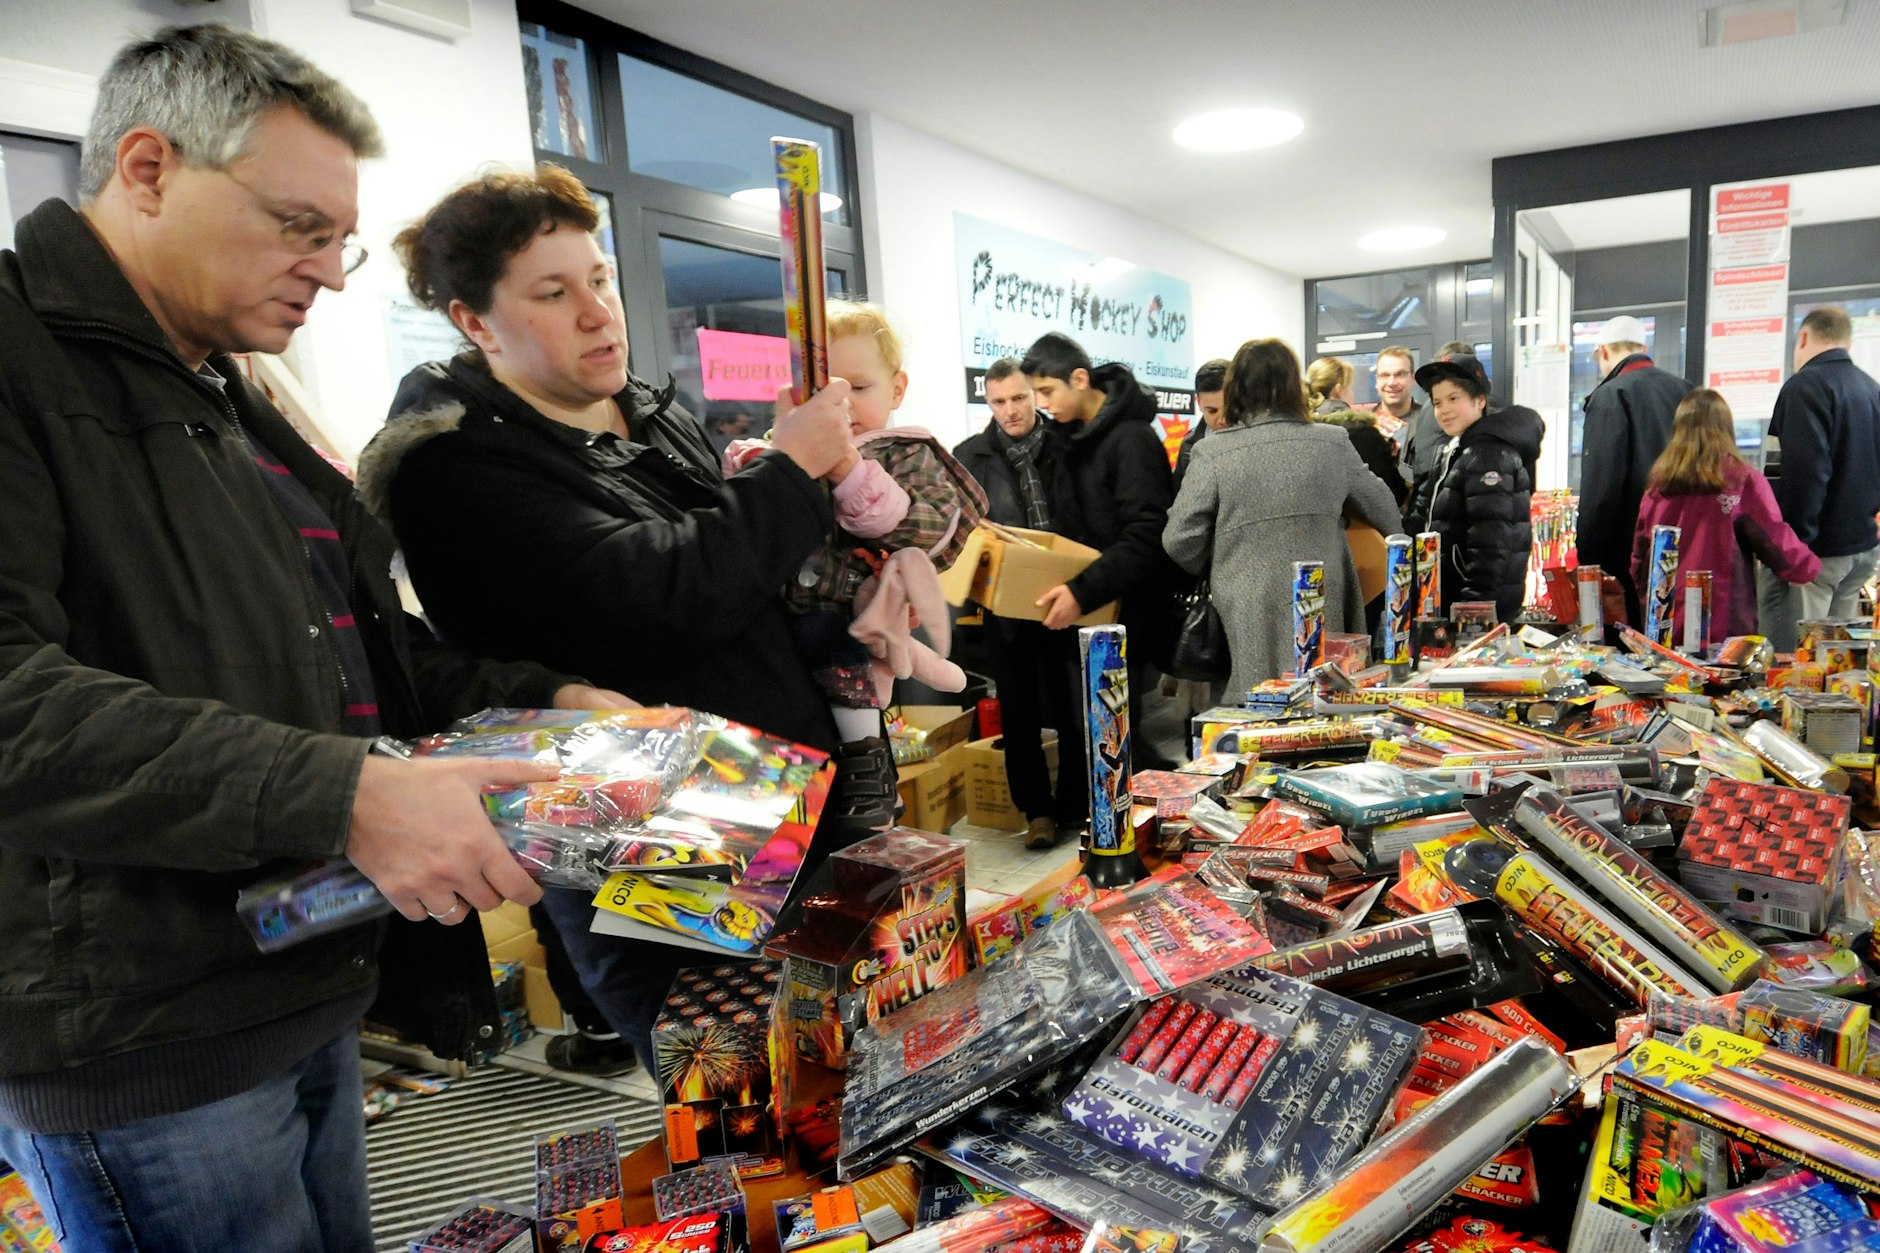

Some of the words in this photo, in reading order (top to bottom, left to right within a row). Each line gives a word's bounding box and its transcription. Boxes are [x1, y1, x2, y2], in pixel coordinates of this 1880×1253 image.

[1721, 199, 1785, 212] Informationen
[974, 337, 1027, 360] Eishocke
[1566, 752, 1625, 762] Lichterorgel
[1280, 778, 1311, 797] TURBO
[1299, 793, 1333, 813] WIRBEL
[1362, 806, 1400, 819] TURBO
[1385, 807, 1425, 823] WIRBEL
[1505, 864, 1527, 892] NICO
[1545, 803, 1721, 940] FEUER-ROHR
[613, 875, 640, 907] NICO
[896, 905, 958, 957] STEPS
[1527, 883, 1680, 1000] FEUER-RO
[917, 940, 943, 967] TO
[1347, 940, 1428, 972] Lichterorgel
[1717, 949, 1745, 975] NICO
[873, 960, 937, 1018] HELL
[1206, 975, 1299, 1016] Eisfontä
[1319, 1005, 1342, 1017] NICO
[1501, 1004, 1524, 1025] 400
[1370, 1023, 1394, 1036] NICO
[1426, 1026, 1478, 1053] CRACKER
[1717, 1040, 1753, 1055] NICO
[1421, 1051, 1461, 1070] ACKER
[1665, 1054, 1701, 1072] NICO
[1253, 1012, 1359, 1168] Wunderkerzen
[1411, 1074, 1444, 1092] CKER
[915, 1086, 988, 1130] Wunderkerzen
[1091, 1076, 1220, 1144] Eisfontänen
[1699, 1130, 1717, 1157] 500
[1736, 1126, 1761, 1143] 15
[1460, 1182, 1523, 1205] CRACKER
[1604, 1172, 1616, 1196] NICO
[685, 1220, 716, 1233] 250
